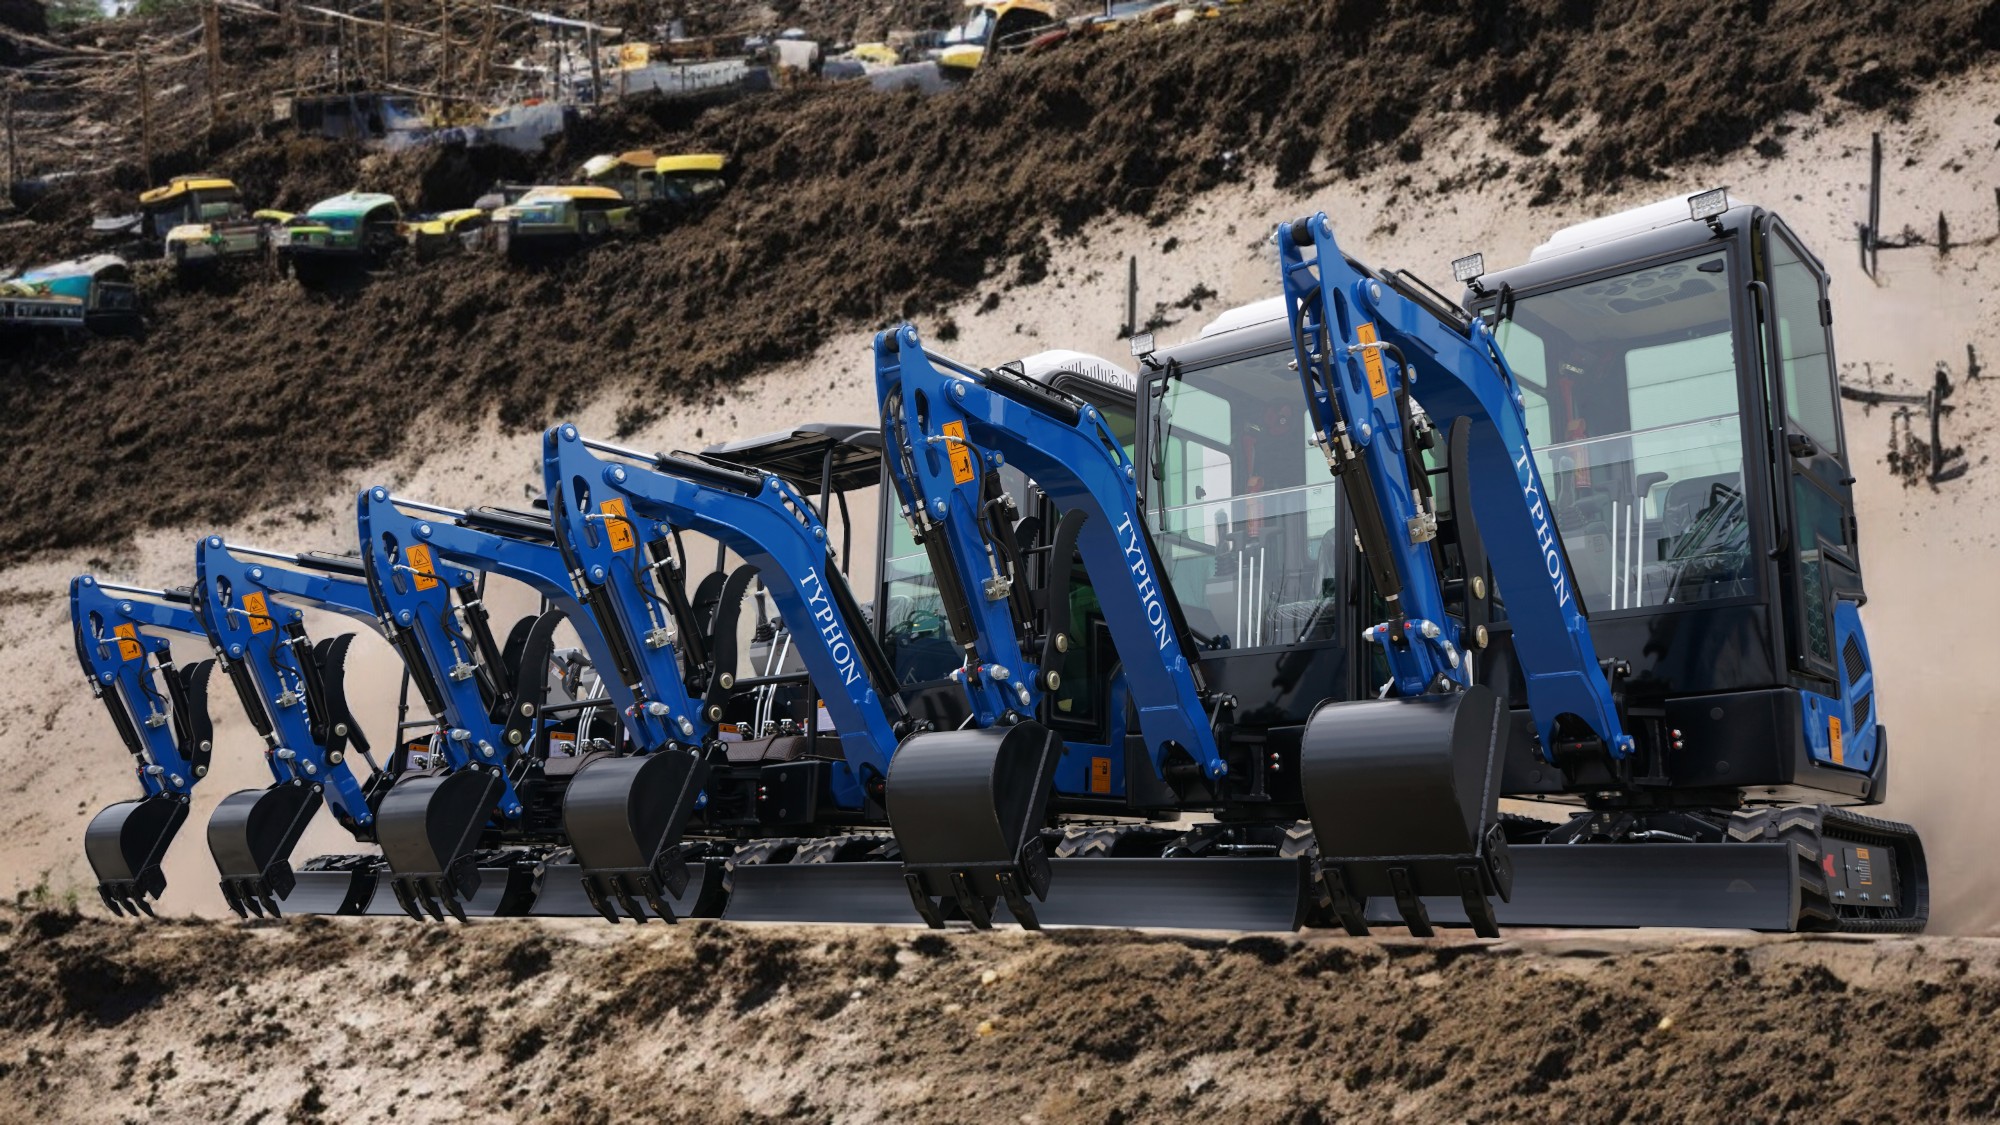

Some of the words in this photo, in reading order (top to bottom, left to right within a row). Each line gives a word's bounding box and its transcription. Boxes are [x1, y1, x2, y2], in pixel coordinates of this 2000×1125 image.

[1118, 512, 1172, 650] TYPHON
[1516, 445, 1570, 607] TYPHON
[800, 567, 861, 686] TYPHON
